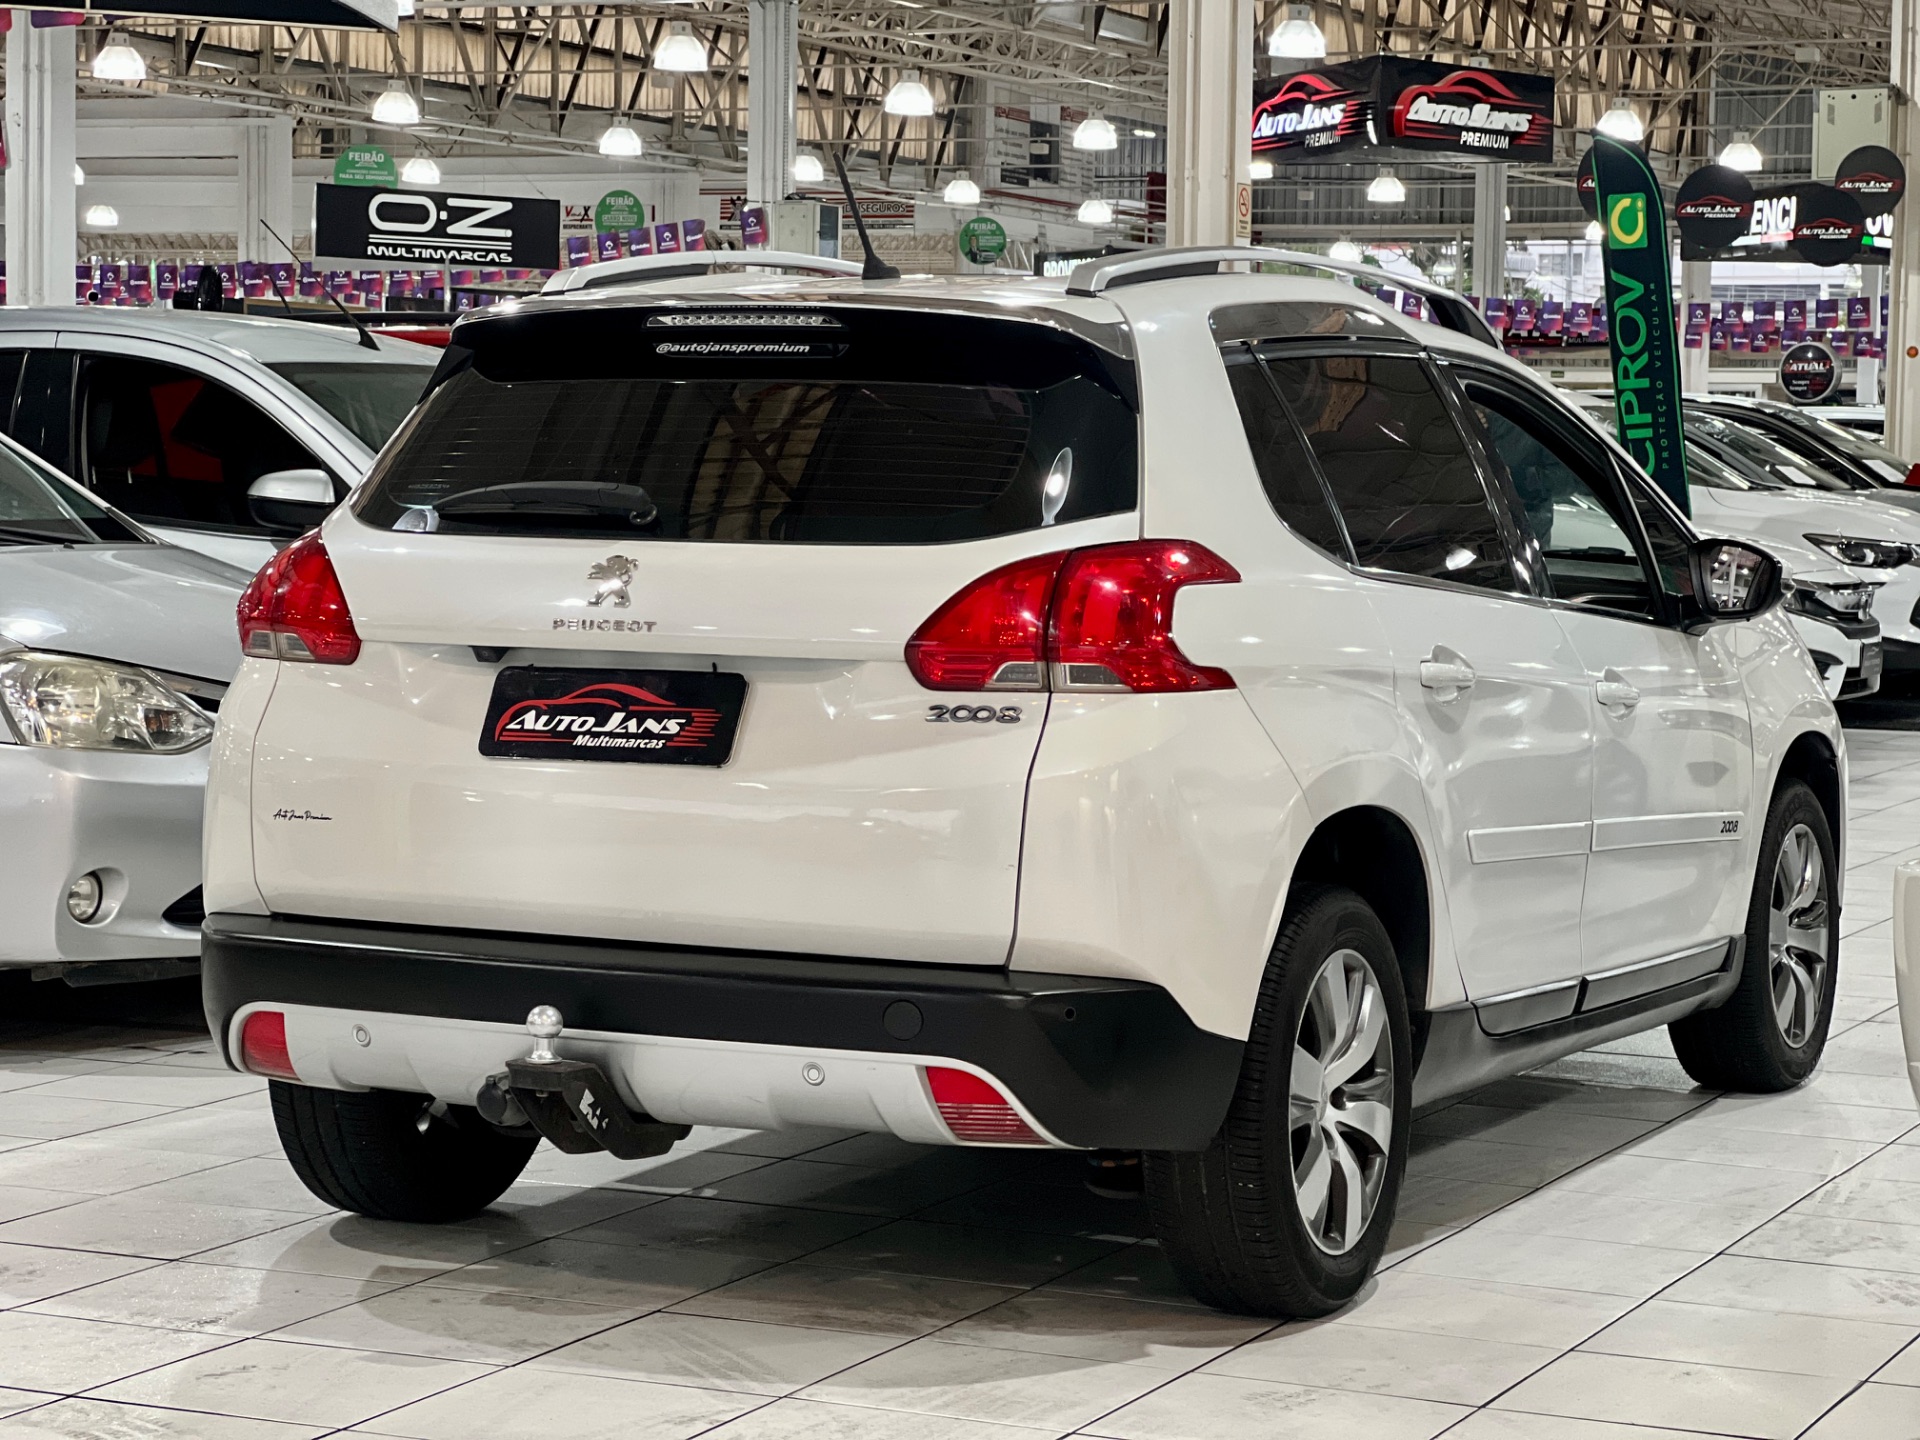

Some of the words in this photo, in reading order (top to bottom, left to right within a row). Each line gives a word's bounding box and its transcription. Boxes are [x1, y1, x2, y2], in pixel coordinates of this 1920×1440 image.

[1304, 130, 1341, 148] PREMIUM
[1460, 131, 1509, 149] PREMIUM
[348, 150, 385, 162] FEIRÃO
[605, 194, 634, 206] FEIRÃO
[970, 221, 997, 230] FEIRÃO
[367, 245, 513, 263] MULTIMARCAS
[1650, 282, 1662, 367] VEICULAR
[656, 342, 810, 354] @autojanspremium
[1610, 267, 1656, 476] CIPROV
[1656, 380, 1670, 469] PROTEÇÃO
[552, 618, 657, 632] PEUGEOT
[925, 704, 1023, 723] 2008
[572, 734, 667, 749] Multimarcas
[1720, 820, 1739, 833] 2008
